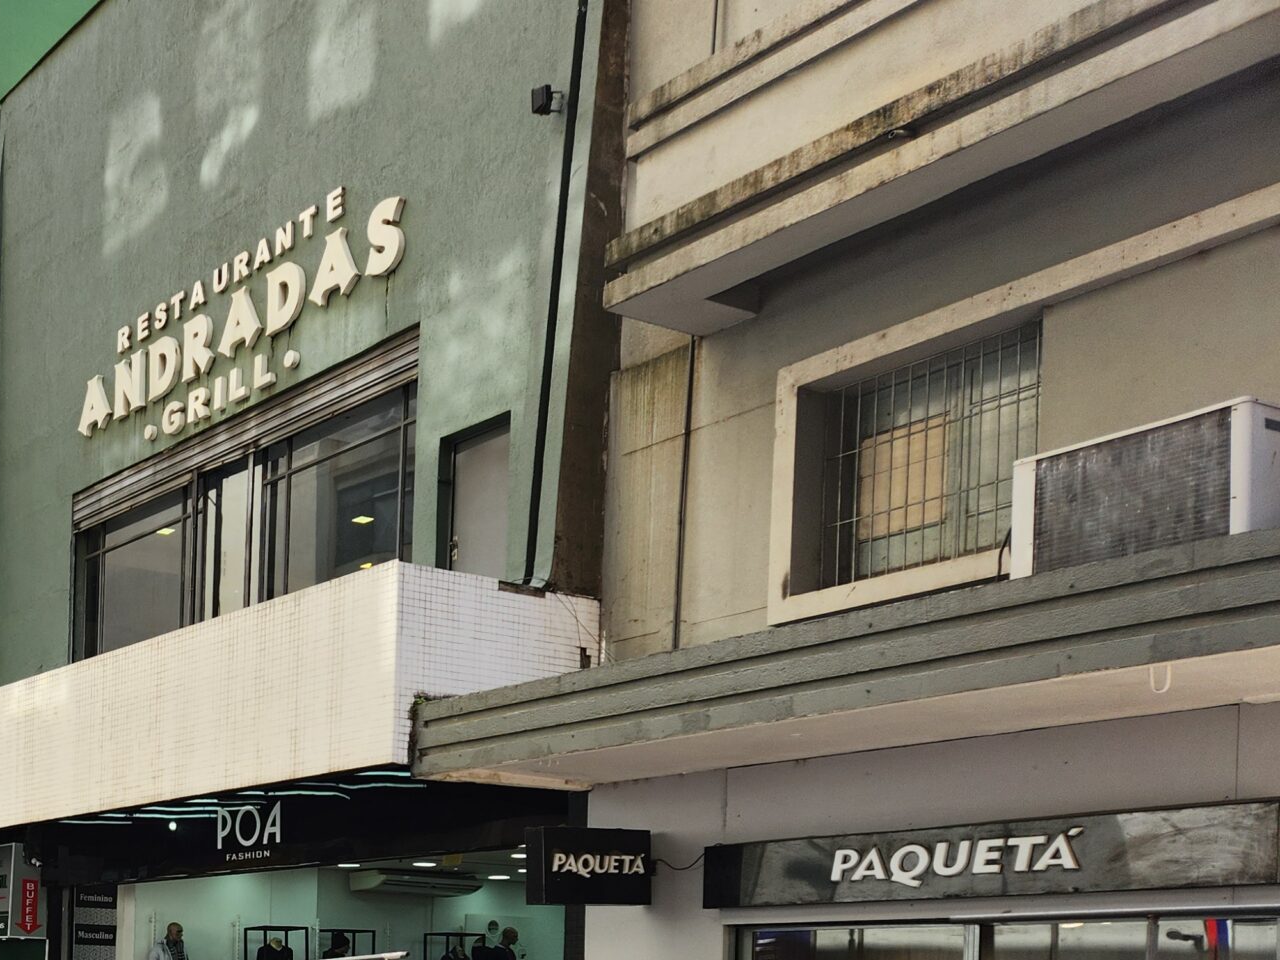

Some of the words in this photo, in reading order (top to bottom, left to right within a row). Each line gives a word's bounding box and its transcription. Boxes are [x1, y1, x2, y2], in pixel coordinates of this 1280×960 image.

[116, 185, 347, 354] RESTAURANTE
[76, 195, 407, 437] ANDRADAS
[161, 355, 276, 436] GRILL
[217, 800, 281, 849] POA
[225, 849, 270, 861] FASHION
[551, 852, 646, 879] PAQUETÁ
[829, 826, 1083, 888] PAQUETÁ
[25, 882, 34, 931] BUFFET
[80, 893, 113, 903] Feminino
[77, 930, 114, 940] Masculino
